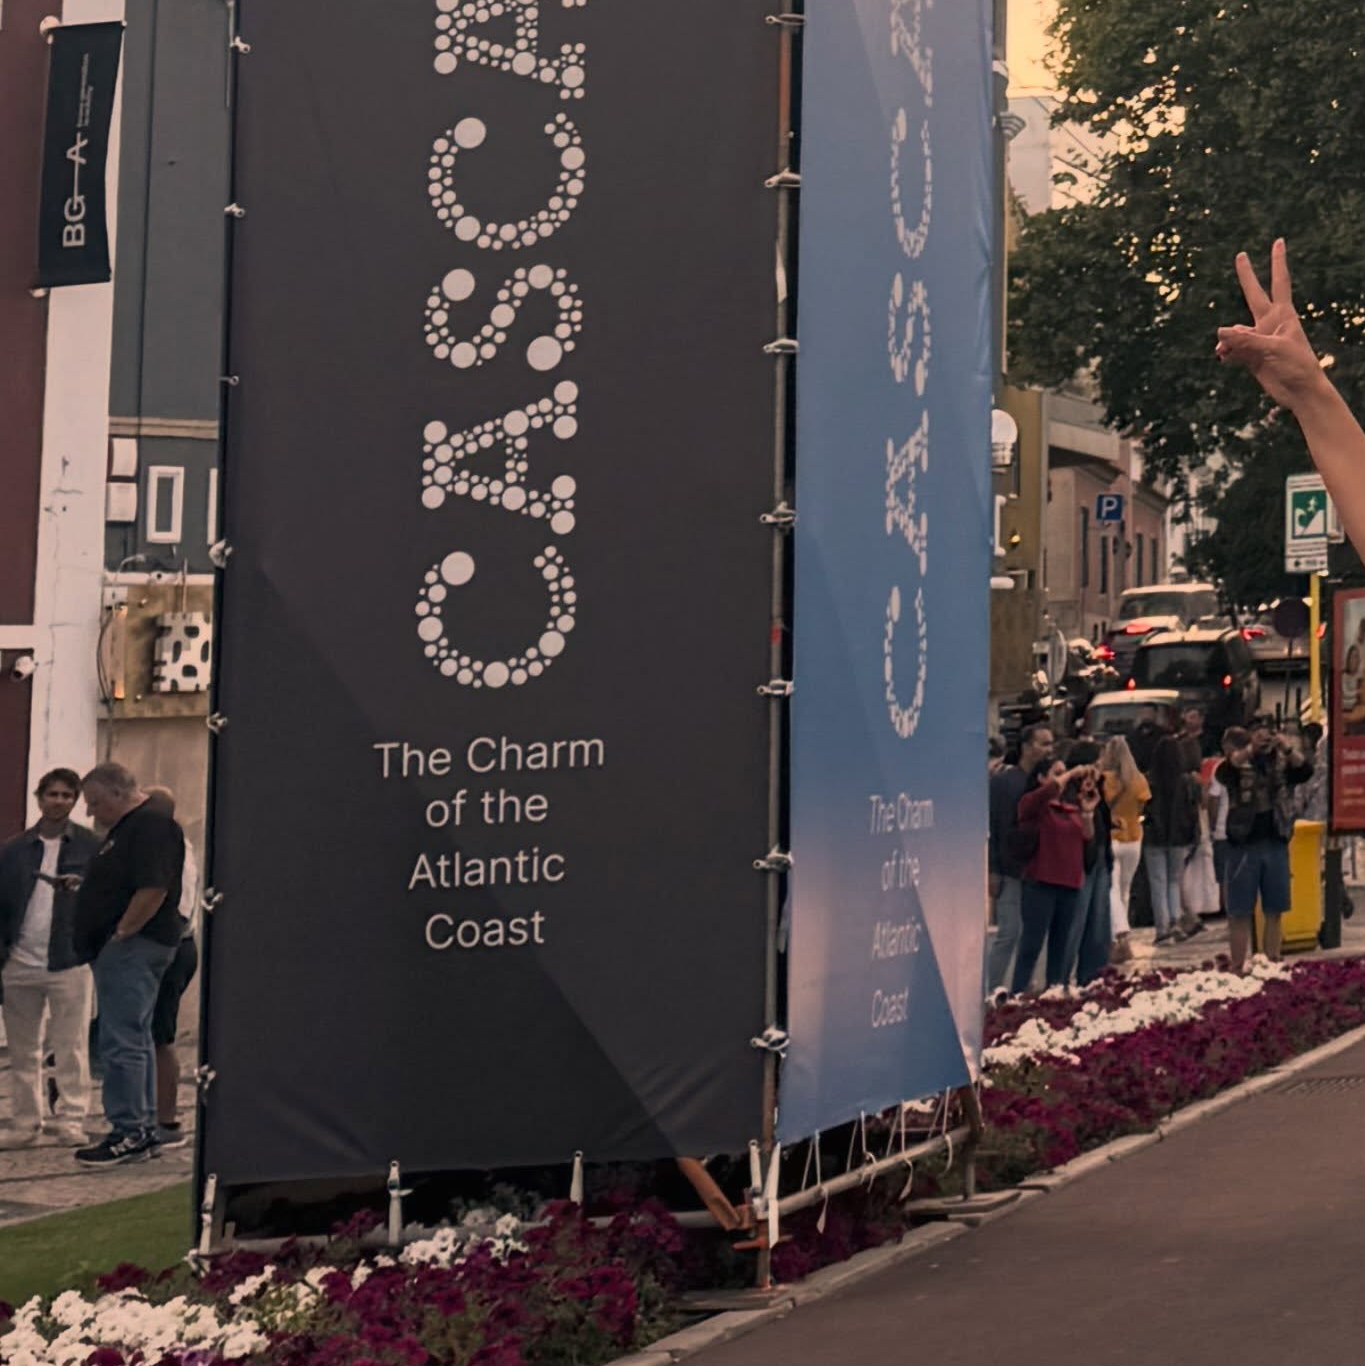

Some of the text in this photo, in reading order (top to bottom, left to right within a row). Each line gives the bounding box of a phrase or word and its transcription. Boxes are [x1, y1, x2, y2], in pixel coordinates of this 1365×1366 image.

[373, 736, 605, 779] The Charm
[425, 789, 548, 828] of the
[869, 795, 895, 835] The
[408, 847, 565, 890] Atlantic
[425, 910, 545, 950] Coast
[871, 987, 909, 1028] Coast
